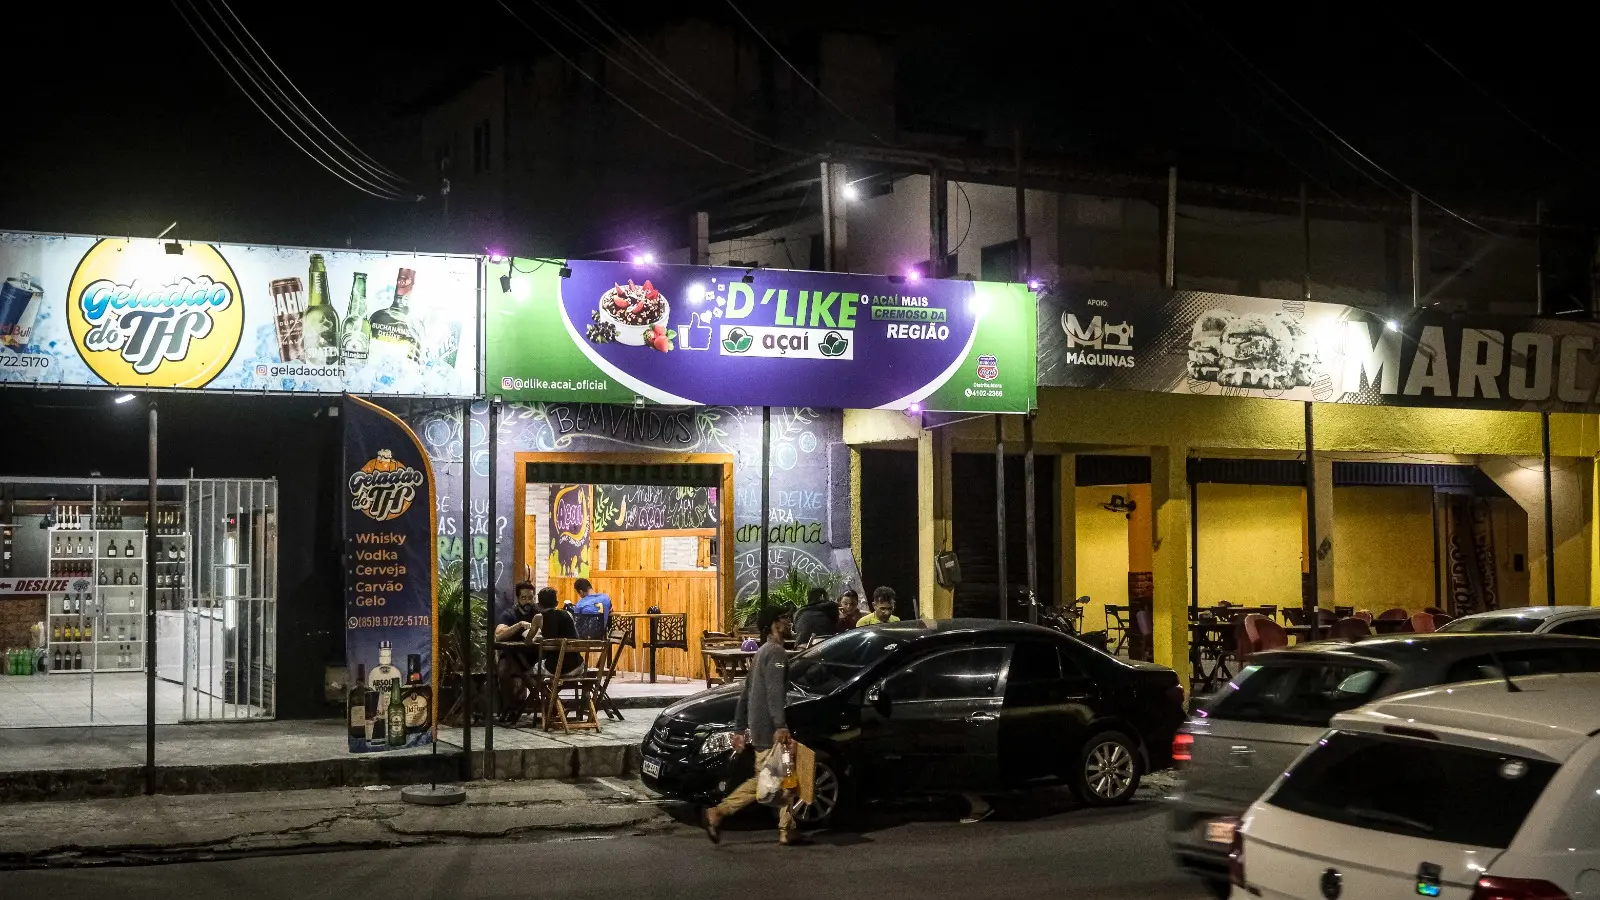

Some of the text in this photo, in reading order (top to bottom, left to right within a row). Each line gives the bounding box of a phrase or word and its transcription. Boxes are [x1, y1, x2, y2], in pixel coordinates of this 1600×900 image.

[872, 293, 899, 307] AÇAÍ
[901, 296, 929, 307] MAIS
[874, 308, 945, 321] CREMOSO DA
[88, 317, 119, 345] do
[886, 323, 950, 341] REGIÃO
[762, 332, 809, 355] açaí
[1066, 350, 1135, 368] MÁQUINAS
[1343, 320, 1600, 403] MAROC
[270, 365, 345, 377] geladaodoth
[513, 378, 607, 391] @dlike.acai_oficial
[352, 491, 368, 508] do
[777, 489, 823, 509] DEIXE
[356, 533, 406, 545] Whisky
[736, 521, 827, 545] amanhã
[356, 550, 398, 561] Vodka
[356, 564, 406, 577] Cerveja
[14, 579, 69, 592] DESLIZE
[356, 580, 404, 593] Carvão
[356, 595, 386, 607] Gelo
